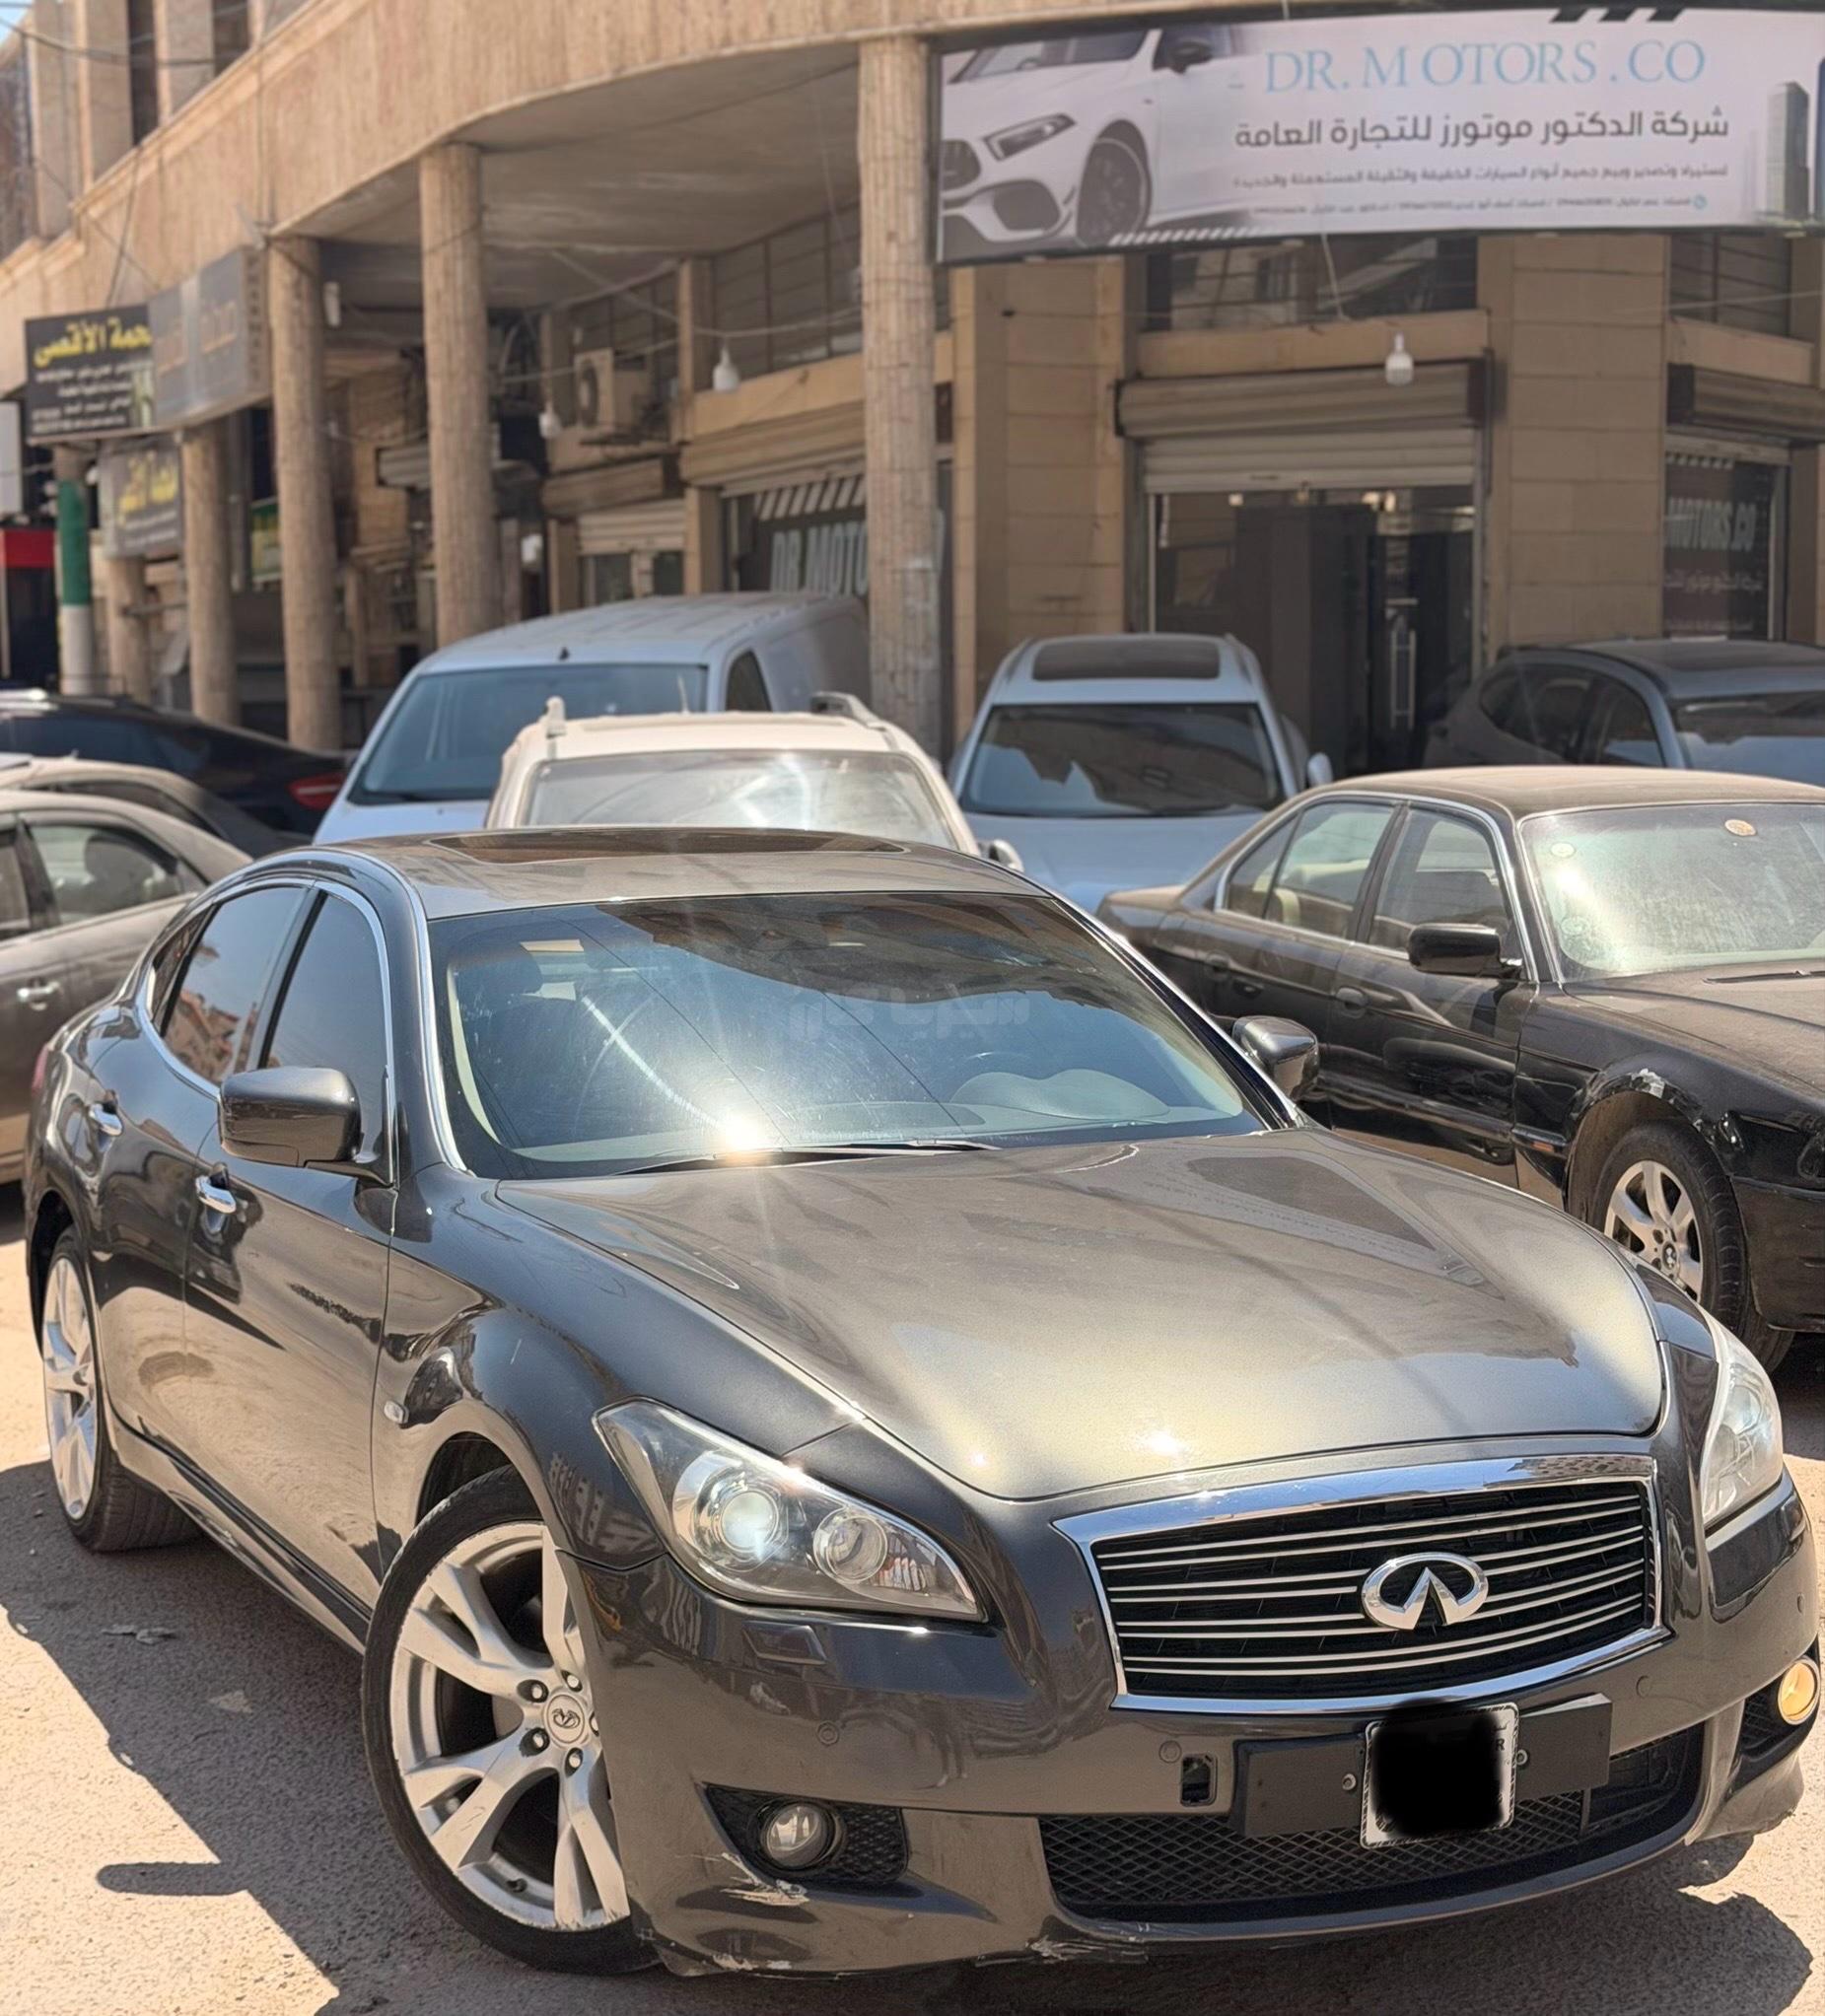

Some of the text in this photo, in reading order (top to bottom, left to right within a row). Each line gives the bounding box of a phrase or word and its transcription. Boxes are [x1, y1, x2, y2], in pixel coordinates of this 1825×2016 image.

[1266, 49, 1350, 94] DR.
[1234, 104, 1728, 151] شركة الدكتور موتورز للتجارة العامة
